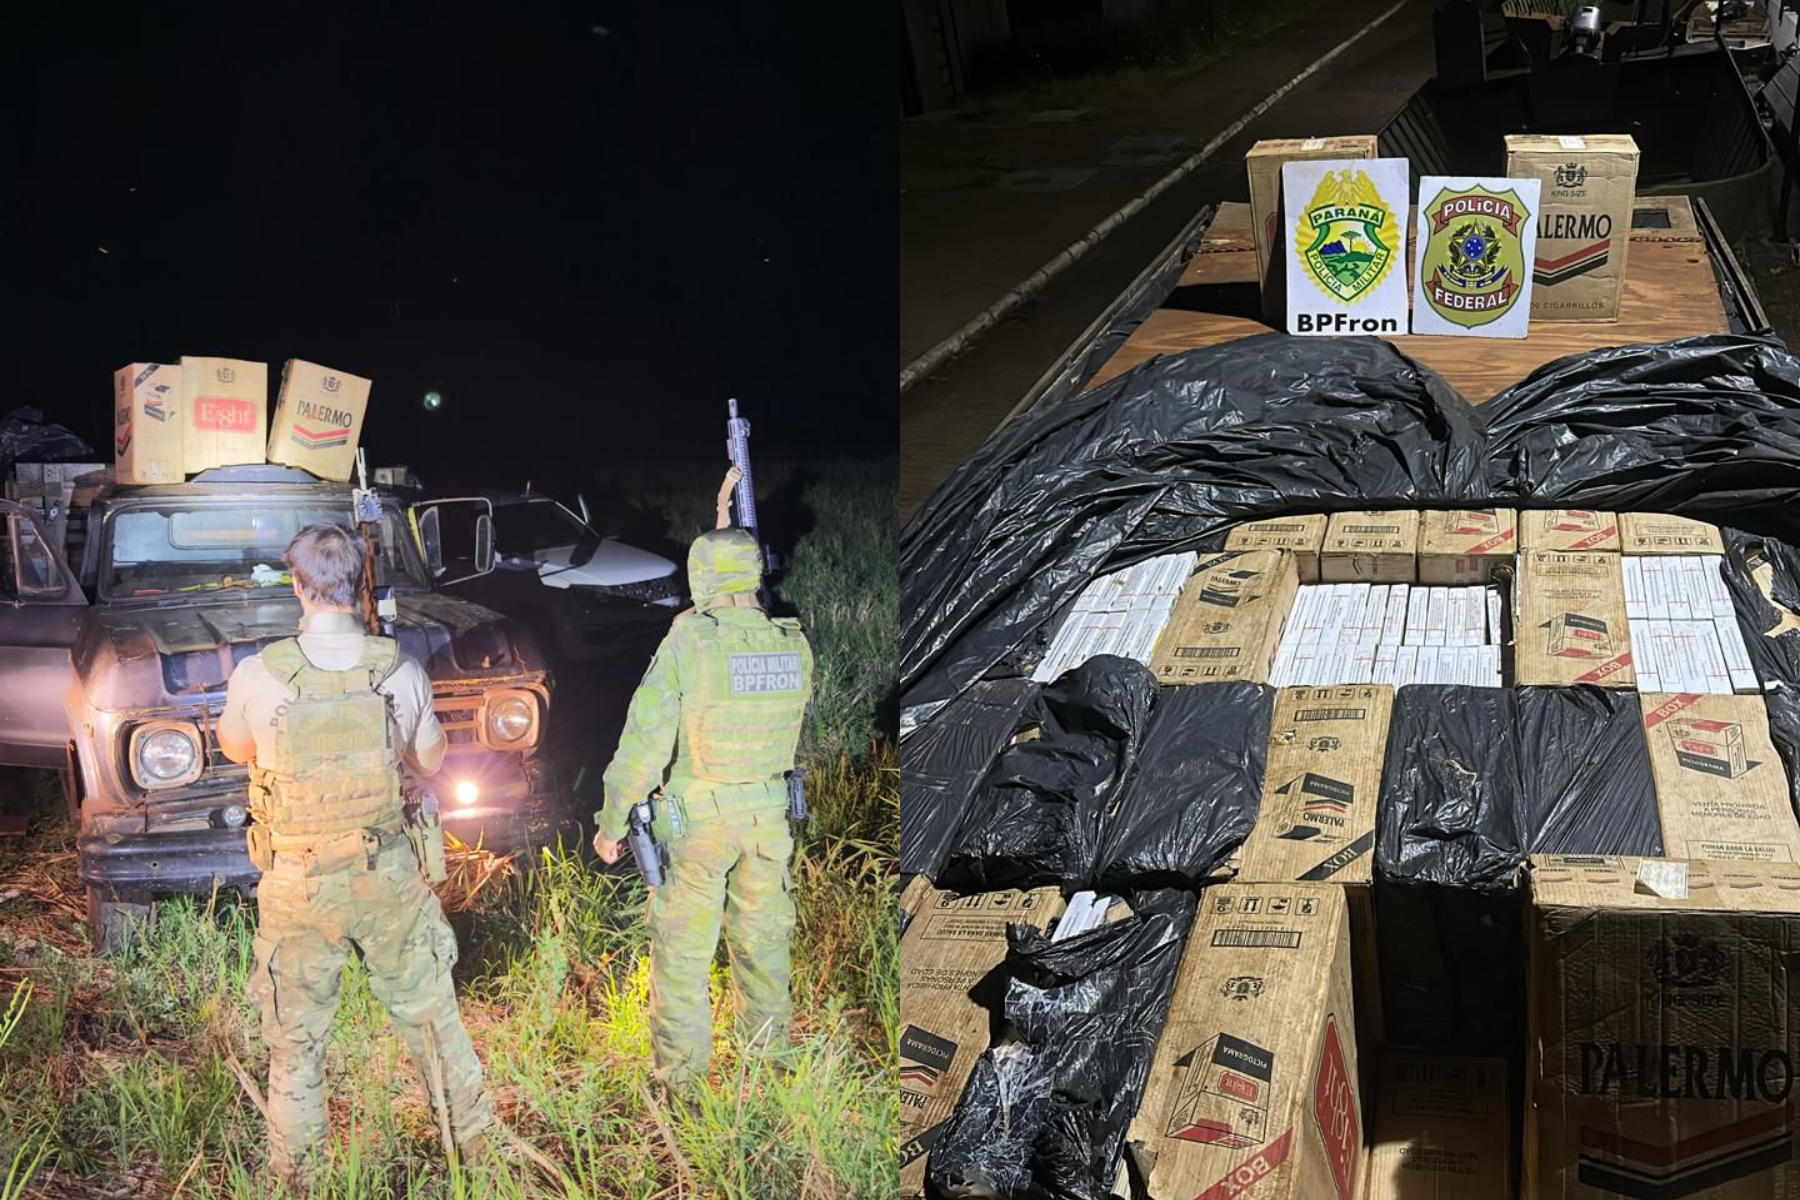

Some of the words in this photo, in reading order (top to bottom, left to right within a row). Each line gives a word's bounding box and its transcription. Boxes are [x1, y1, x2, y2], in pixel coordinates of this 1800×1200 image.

[1313, 208, 1380, 224] PARANÁ
[1537, 214, 1612, 239] LERMO
[1351, 251, 1386, 292] MILITAR
[1435, 288, 1507, 309] FEDERAL
[1297, 314, 1397, 332] BPFron
[202, 403, 251, 429] Eight
[297, 400, 353, 428] PALERMO
[733, 673, 801, 691] BPFRON
[1655, 698, 1686, 718] BOX
[1303, 812, 1345, 828] PALERMO
[1323, 848, 1358, 873] BOX
[949, 969, 985, 977] ENORES
[907, 1038, 950, 1059] PICTOGRAMA
[1223, 1046, 1267, 1069] PICTOGRAMA
[1580, 1041, 1794, 1104] PALERMO
[900, 1089, 927, 1109] PALE
[1220, 1155, 1271, 1196] BOX
